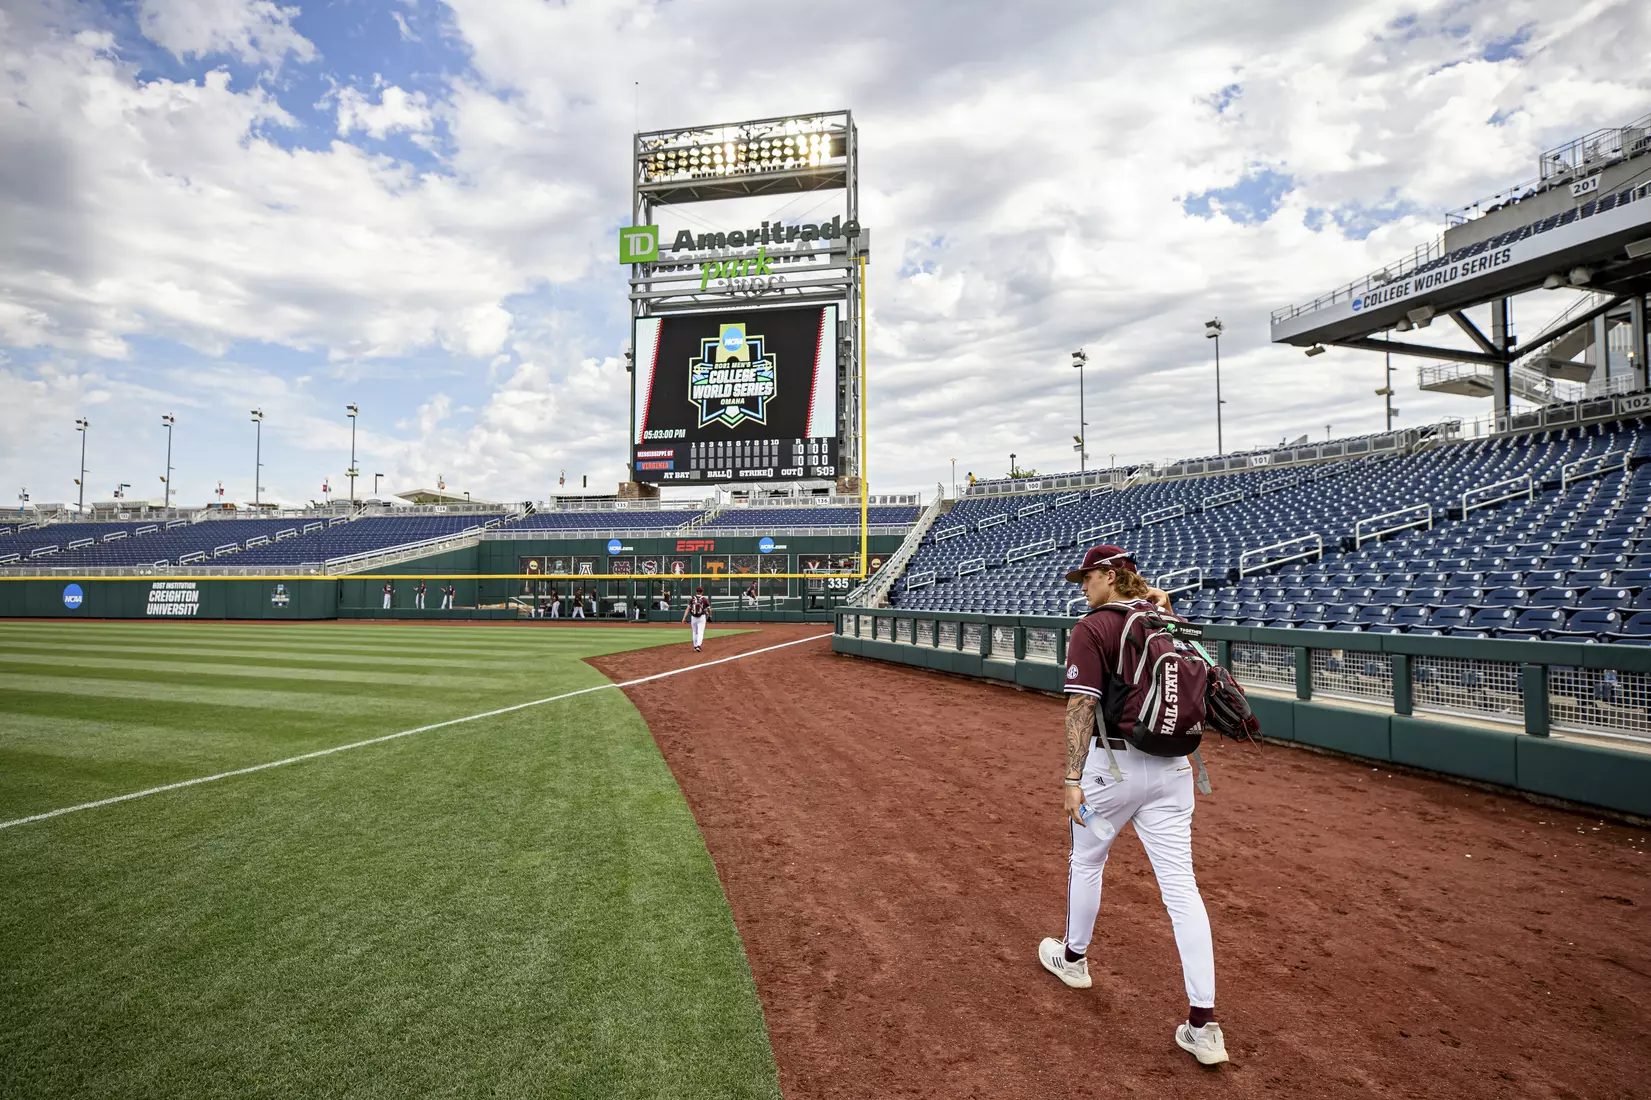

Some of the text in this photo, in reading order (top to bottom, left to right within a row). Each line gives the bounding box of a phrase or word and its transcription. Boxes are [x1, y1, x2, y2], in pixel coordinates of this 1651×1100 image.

[1574, 178, 1597, 194] 201
[672, 215, 860, 252] Ameritrade
[624, 233, 654, 256] TD
[701, 246, 774, 291] park
[1363, 248, 1511, 309] COLLEGE WORLD SERIES
[709, 368, 757, 384] COLLEGE
[692, 382, 773, 399] WORLD SERIES
[1626, 397, 1650, 409] 102
[643, 429, 686, 439] 05:03:00 PM
[798, 444, 828, 454] 0 0 0
[798, 455, 828, 466] 0 0 0
[1254, 456, 1266, 464] 101
[817, 467, 834, 476] 5:03
[676, 540, 714, 552] ESPN
[828, 578, 849, 588] 335
[148, 590, 199, 602] CREIGHTON
[146, 603, 199, 615] UNIVERSITY
[1161, 662, 1178, 735] HAIL STATE
